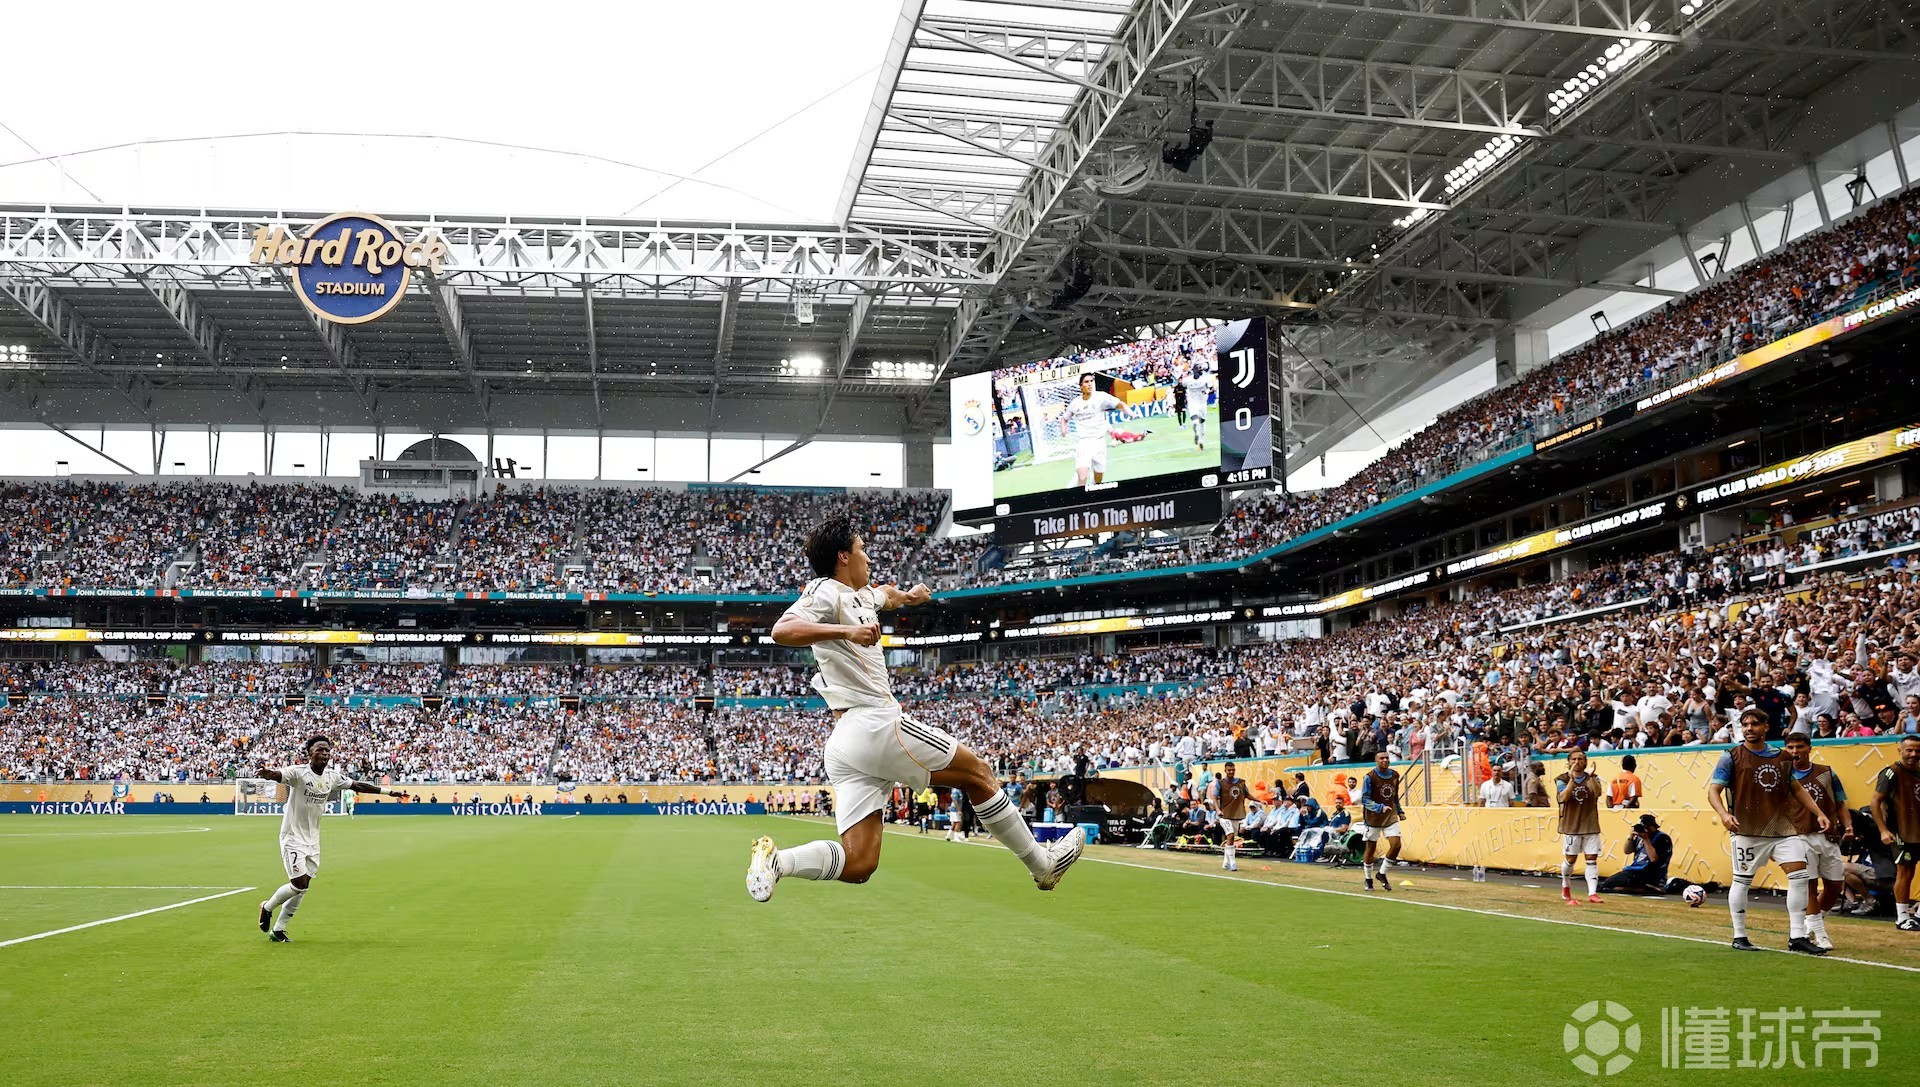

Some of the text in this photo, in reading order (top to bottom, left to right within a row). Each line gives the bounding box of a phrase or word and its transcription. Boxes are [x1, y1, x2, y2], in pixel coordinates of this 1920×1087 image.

[249, 226, 448, 275] Hard Rock
[315, 281, 385, 295] STADIUM
[1844, 310, 1867, 328] FIFA
[1867, 298, 1896, 318] CLUB
[1637, 400, 1652, 412] FIFA
[1896, 427, 1920, 448] FIF
[1252, 468, 1267, 480] PM
[1697, 490, 1720, 504] FIFA
[1720, 483, 1746, 498] CLUB
[1747, 468, 1787, 492] WORLD
[1788, 462, 1812, 480] CUP
[1033, 500, 1174, 536] Take It To The World
[1555, 532, 1572, 544] FIFA
[1572, 524, 1592, 540] CLUB
[1592, 516, 1622, 533] WORLD
[1622, 510, 1640, 525] CUP
[1447, 563, 1460, 575] FIFA
[1460, 558, 1476, 572] CLUB
[1263, 607, 1282, 616] FIFA
[1282, 604, 1304, 615] CLUB
[1127, 618, 1144, 628] FIFA
[1144, 617, 1164, 626] CLUB
[1164, 615, 1194, 624] WORLD
[1194, 613, 1210, 622] CUP
[86, 632, 103, 640] FIFA
[104, 632, 124, 640] CLUB
[124, 632, 154, 640] WORLD
[222, 632, 239, 641] FIFA
[240, 632, 260, 641] CLUB
[260, 632, 290, 641] WORLD
[358, 634, 374, 642] FIFA
[375, 634, 396, 642] CLUB
[396, 634, 425, 642] WORLD
[492, 634, 510, 642] FIFA
[510, 634, 530, 642] CLUB
[531, 634, 559, 642] WORLD
[906, 636, 925, 645] CLUB
[925, 634, 948, 644] WORLD
[948, 634, 963, 643] CUP
[1004, 629, 1020, 638] FIFA
[1020, 628, 1038, 636] CLUB
[626, 636, 644, 644] FIFA
[644, 636, 664, 644] CLUB
[665, 636, 693, 644] WORLD
[30, 802, 126, 814] visitQATAR
[452, 803, 542, 816] visitQATAR
[658, 802, 747, 815] visitQATAR
[290, 851, 298, 865] 7
[1737, 847, 1754, 862] 35
